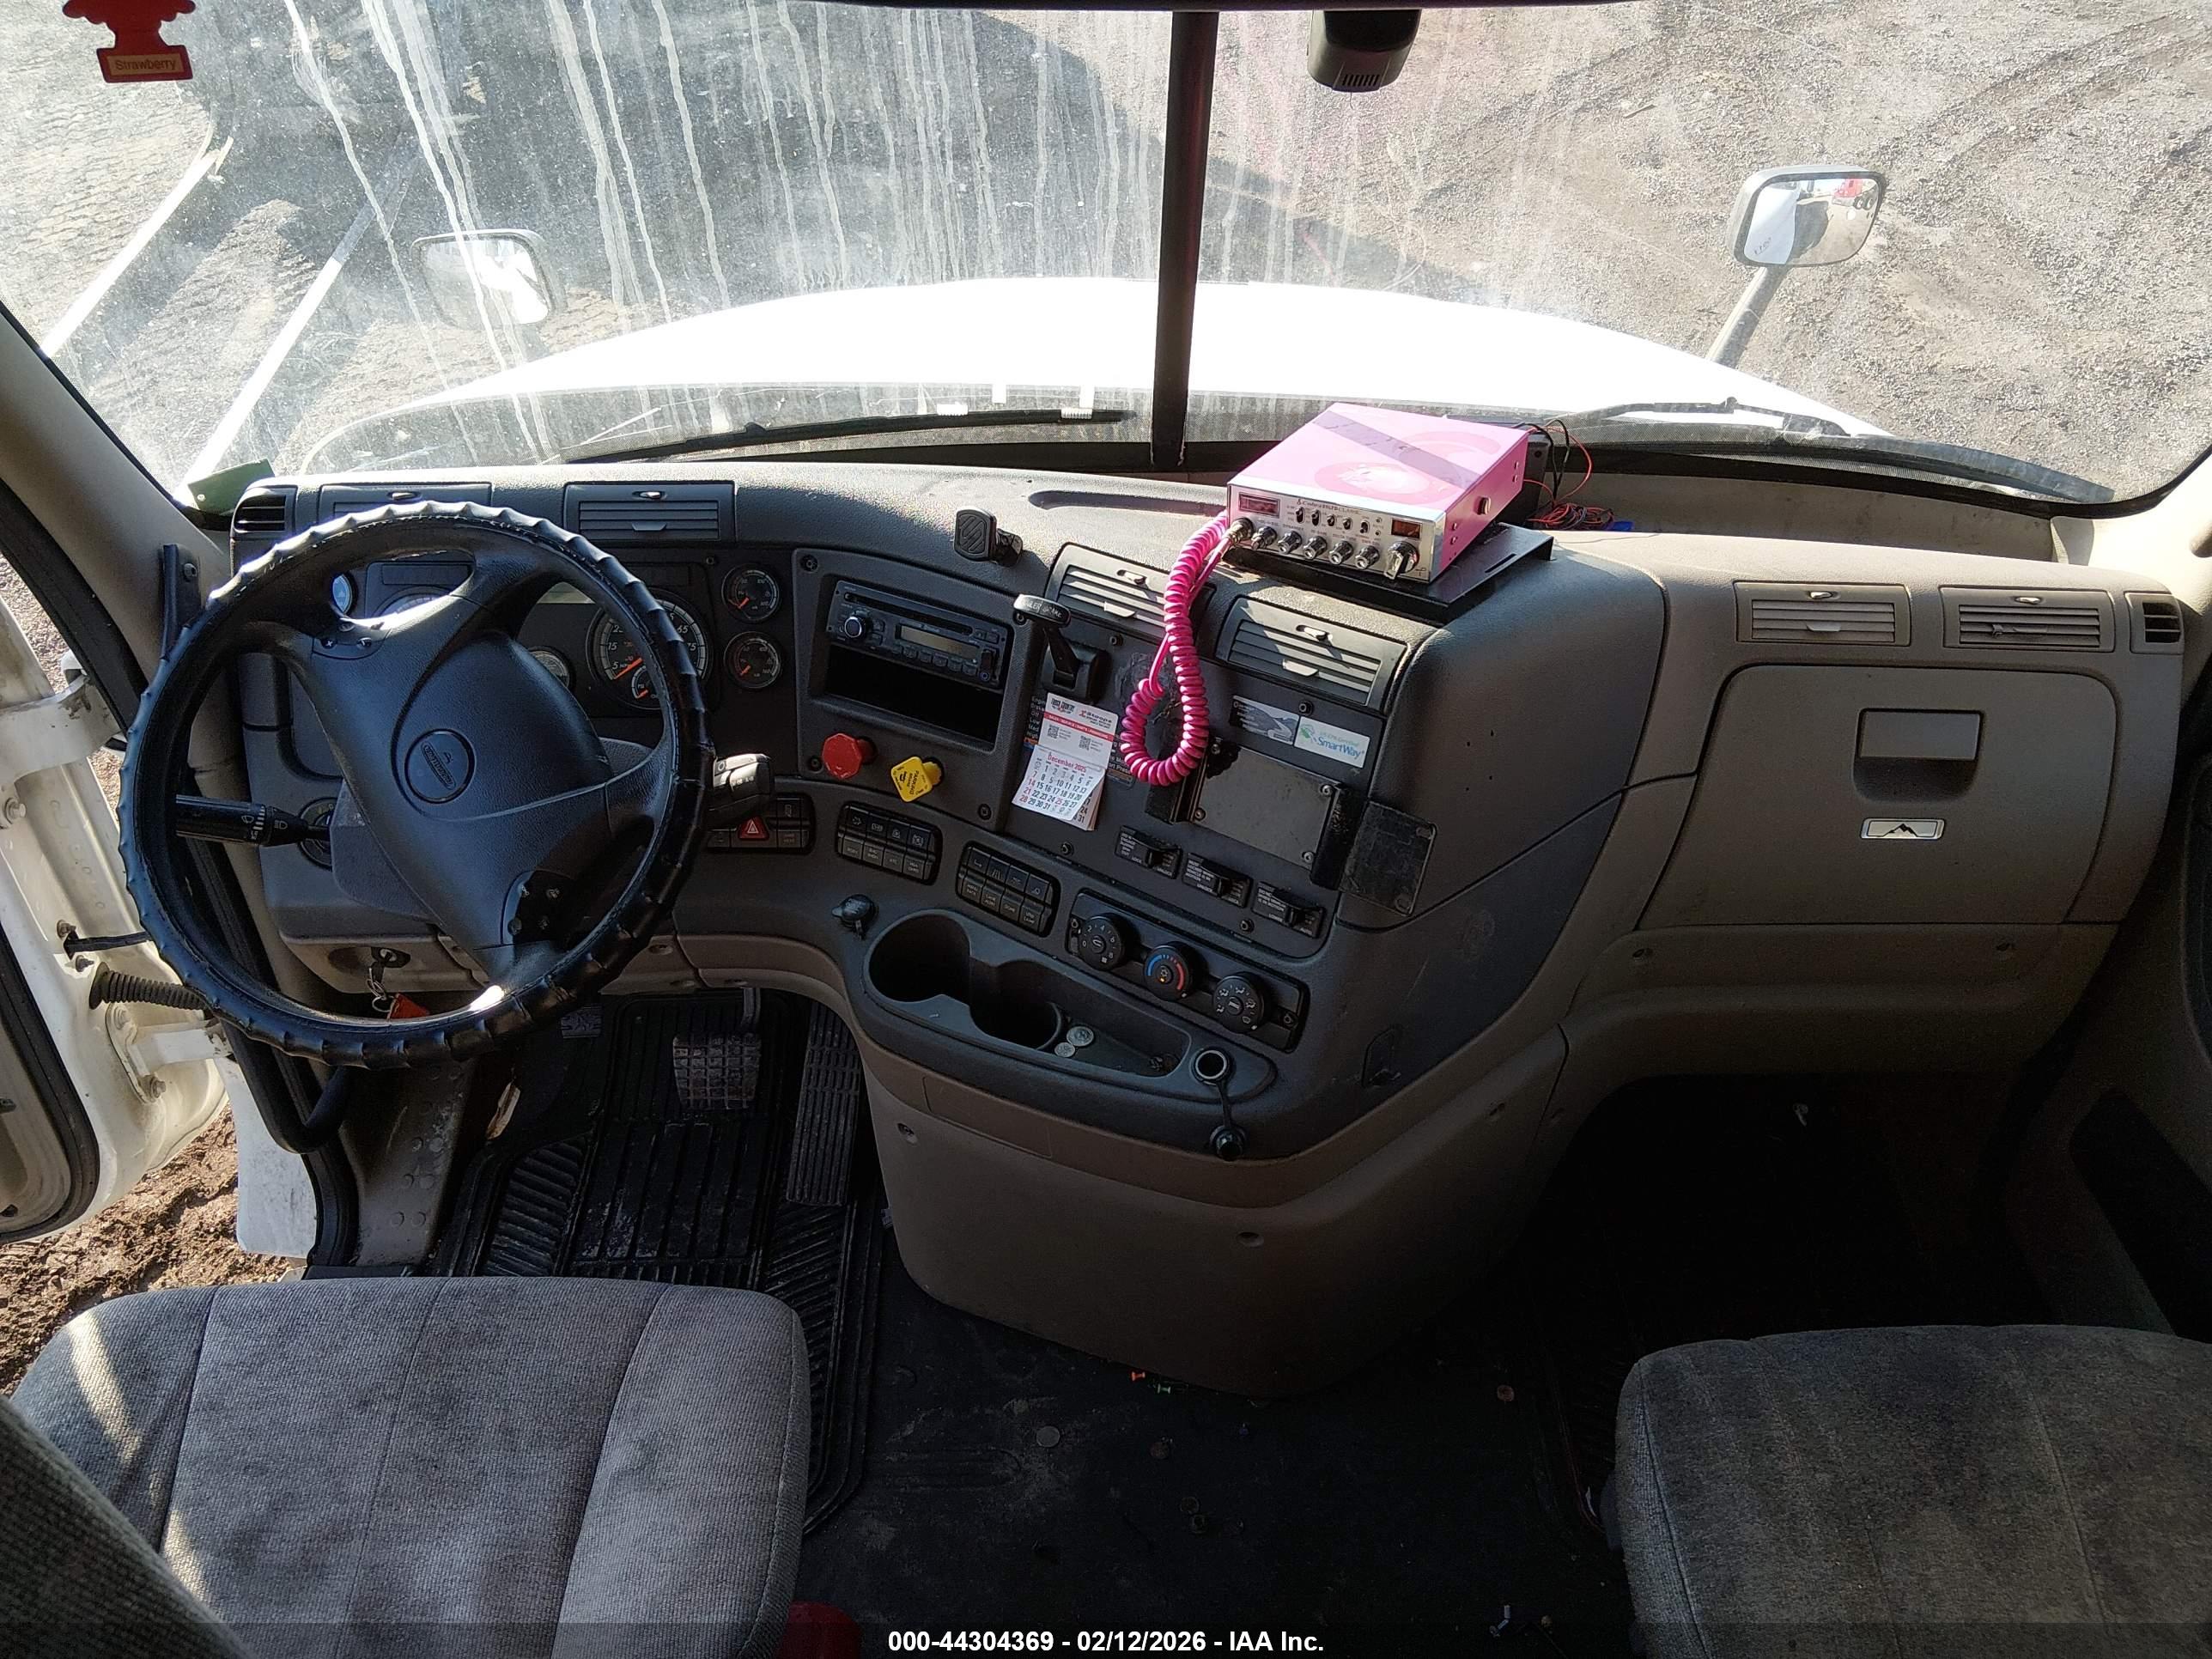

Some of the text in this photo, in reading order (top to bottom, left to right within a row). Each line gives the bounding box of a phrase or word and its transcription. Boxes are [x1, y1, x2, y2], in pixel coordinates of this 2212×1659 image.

[114, 58, 177, 72] Strawberry
[678, 625, 689, 634] 65
[608, 642, 618, 651] 15
[612, 661, 619, 670] 5
[1318, 736, 1361, 760] SmartWay
[1048, 751, 1087, 773] December 2025
[1045, 784, 1052, 793] 16
[1081, 806, 1088, 815] 24
[1078, 815, 1085, 823] 31
